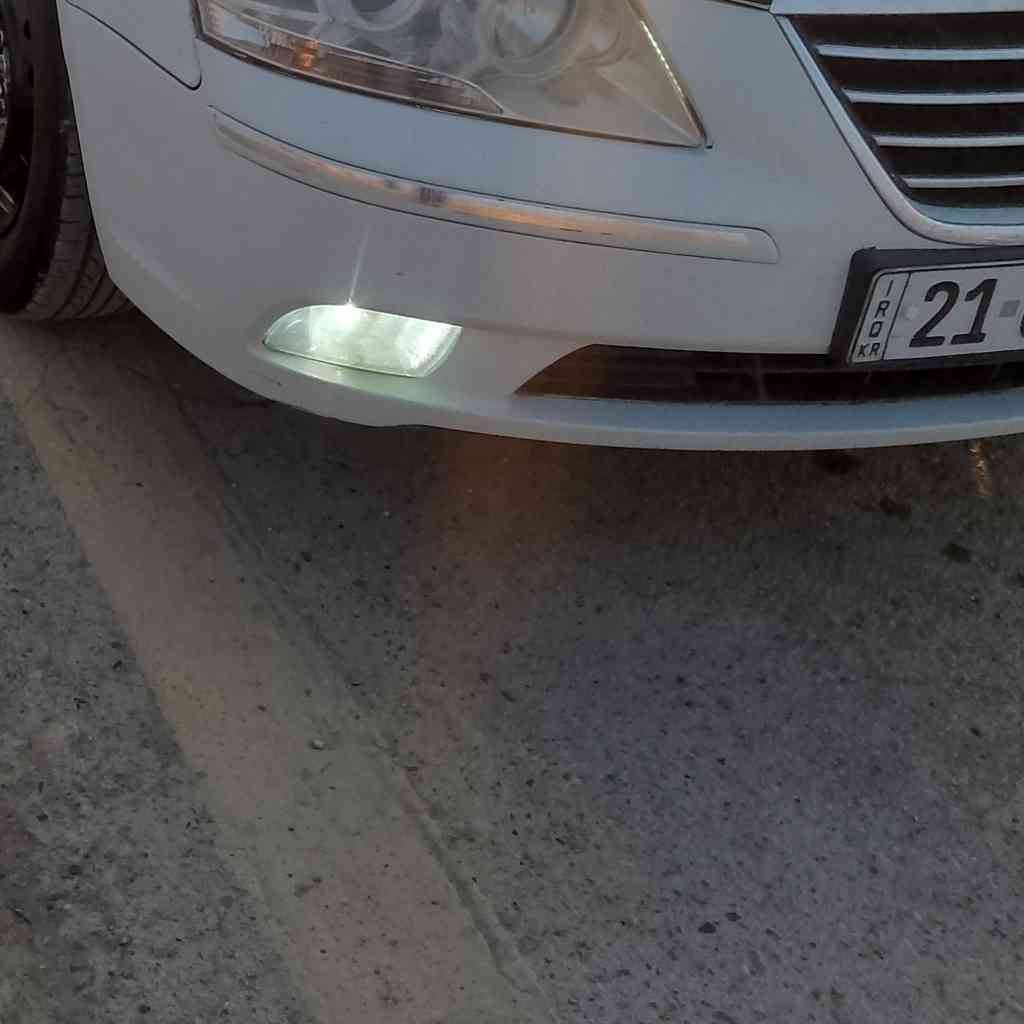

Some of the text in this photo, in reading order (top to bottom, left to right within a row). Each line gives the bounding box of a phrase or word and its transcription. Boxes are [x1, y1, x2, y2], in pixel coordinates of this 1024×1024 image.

[868, 279, 894, 338] IRQ
[909, 278, 998, 348] 21
[857, 342, 881, 358] KR
